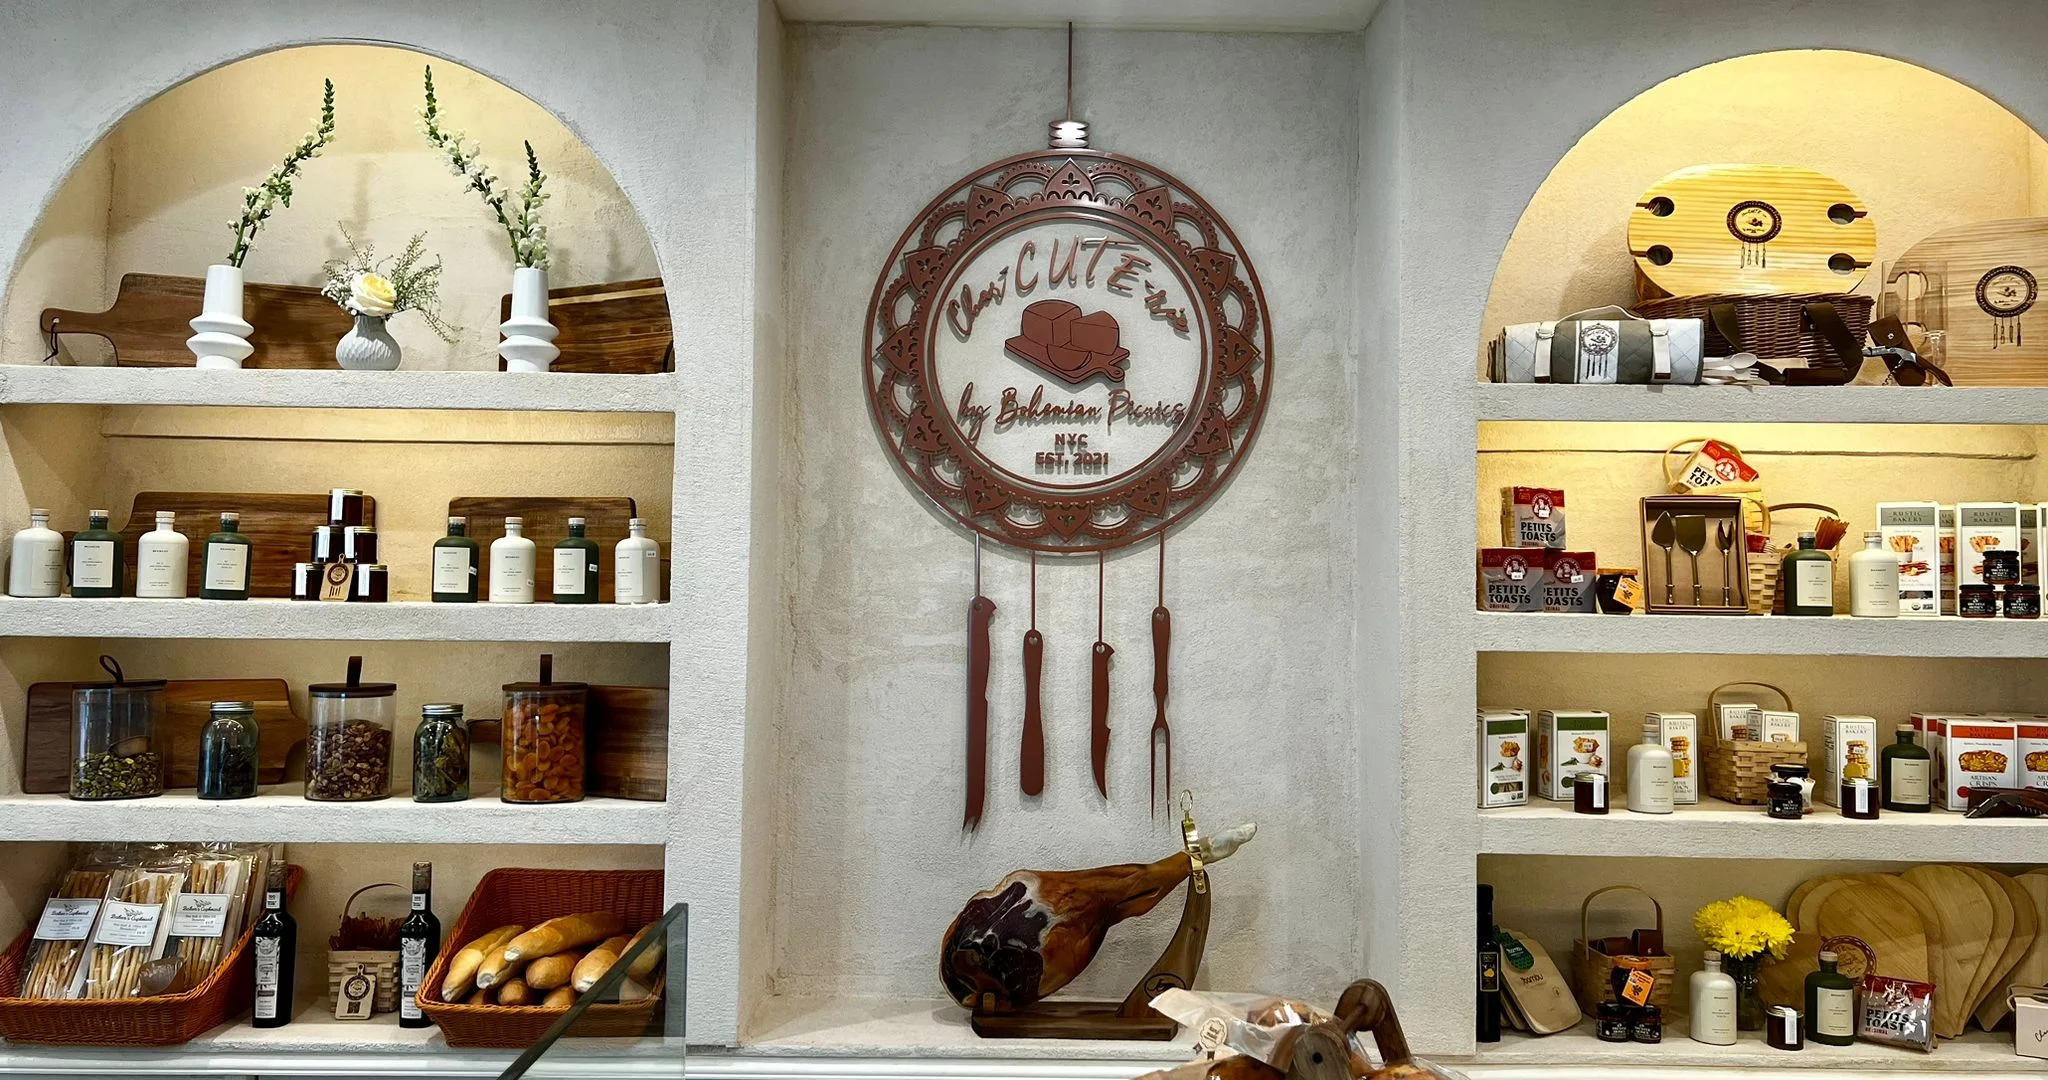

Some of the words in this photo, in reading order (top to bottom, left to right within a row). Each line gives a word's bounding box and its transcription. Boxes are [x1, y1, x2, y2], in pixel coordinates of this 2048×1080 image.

[958, 381, 991, 448] by
[995, 384, 1102, 425] Bohemian
[1107, 388, 1187, 427] Picnics
[1054, 433, 1088, 446] NYC
[1073, 451, 1109, 465] 2021
[1689, 472, 1709, 487] TOA
[1520, 522, 1552, 532] PETITS
[1520, 531, 1557, 542] TOASTS
[1488, 585, 1527, 594] PETITS
[1488, 594, 1532, 604] TOASTS
[1866, 1008, 1910, 1023] PETITS
[1865, 1017, 1907, 1031] TOAST
